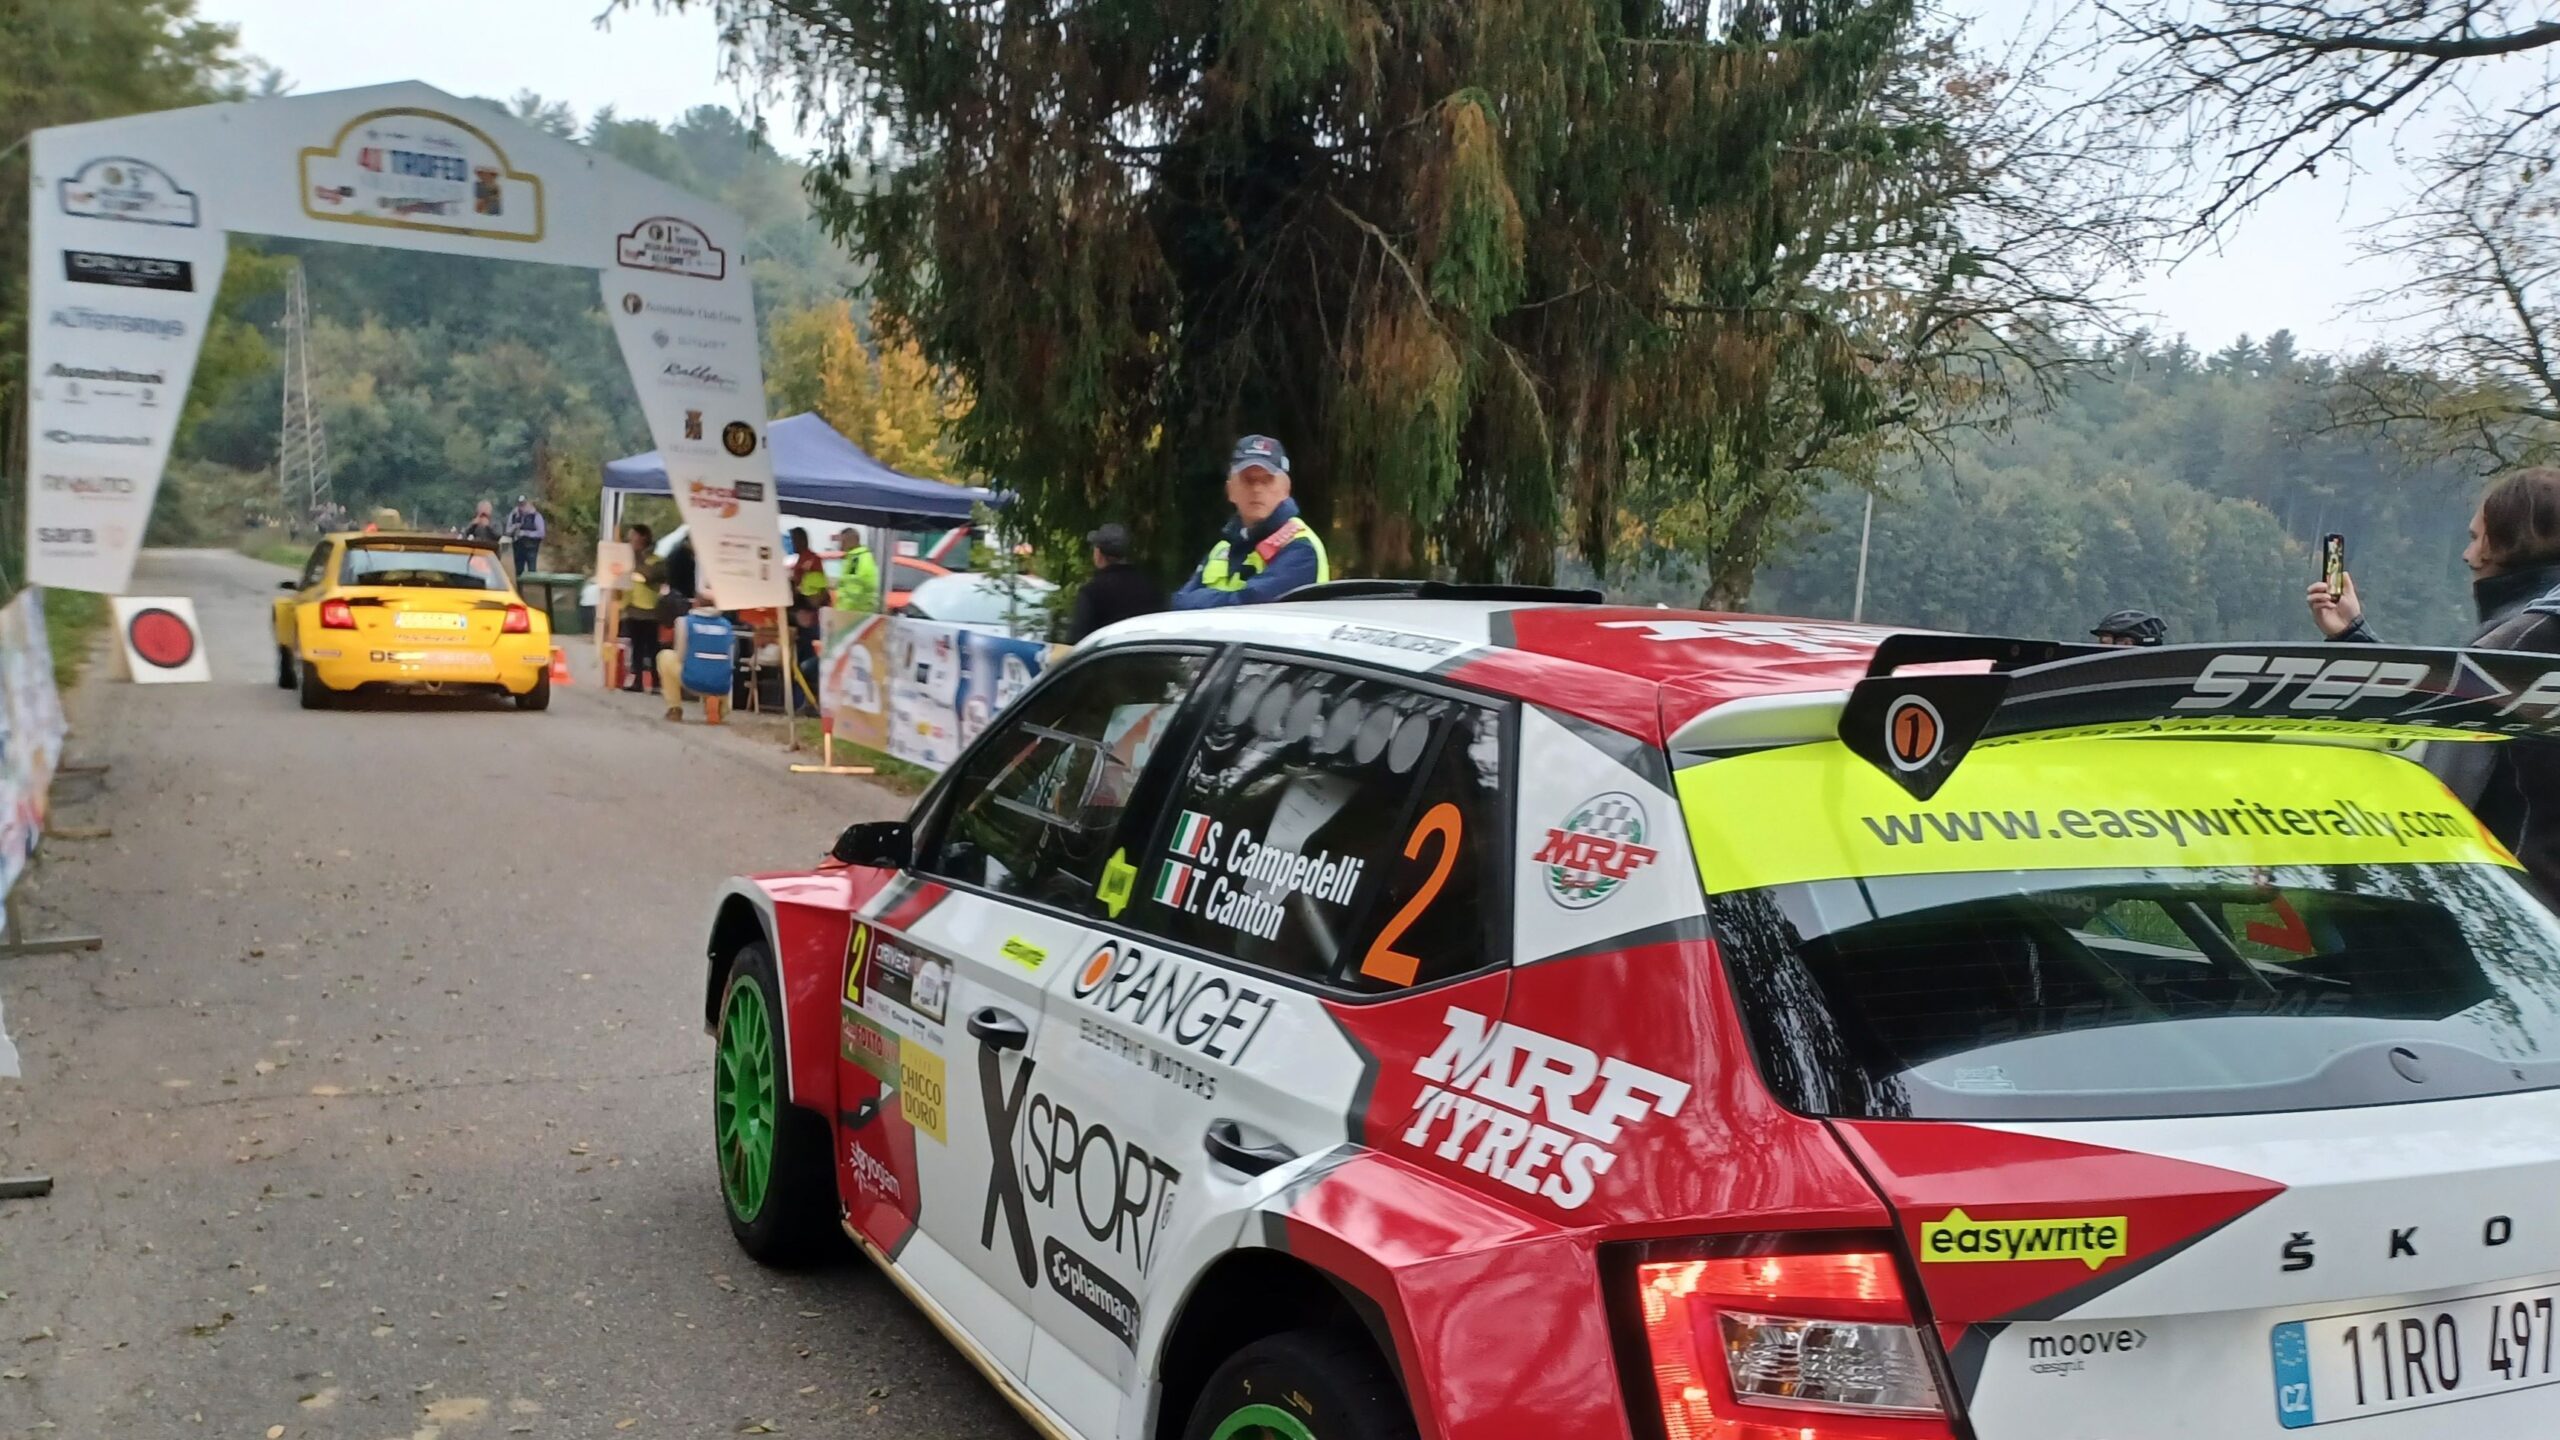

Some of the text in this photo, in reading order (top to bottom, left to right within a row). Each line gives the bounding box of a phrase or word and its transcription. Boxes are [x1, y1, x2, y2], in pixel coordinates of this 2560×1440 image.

[38, 526, 96, 544] sara
[2171, 654, 2431, 710] STEP
[1905, 712, 1919, 762] 1
[1532, 826, 1660, 881] MRF
[1863, 799, 2474, 848] www.easywriterally.com
[1199, 820, 1364, 907] S. Campedelli
[1360, 802, 1462, 988] 2
[1184, 867, 1285, 941] T. Canton
[847, 923, 867, 1003] 2
[875, 943, 911, 973] DRIVER
[1074, 940, 1279, 1067] ORANGE1
[901, 1063, 941, 1106] CHICCO
[1079, 1017, 1219, 1101] ELECTRIC MOTORS
[1412, 1005, 1692, 1144] MRF
[1401, 1084, 1618, 1210] TYRES
[1931, 1222, 2118, 1260] easywrite
[2490, 1296, 2553, 1381] 497
[2280, 1382, 2310, 1414] CZ
